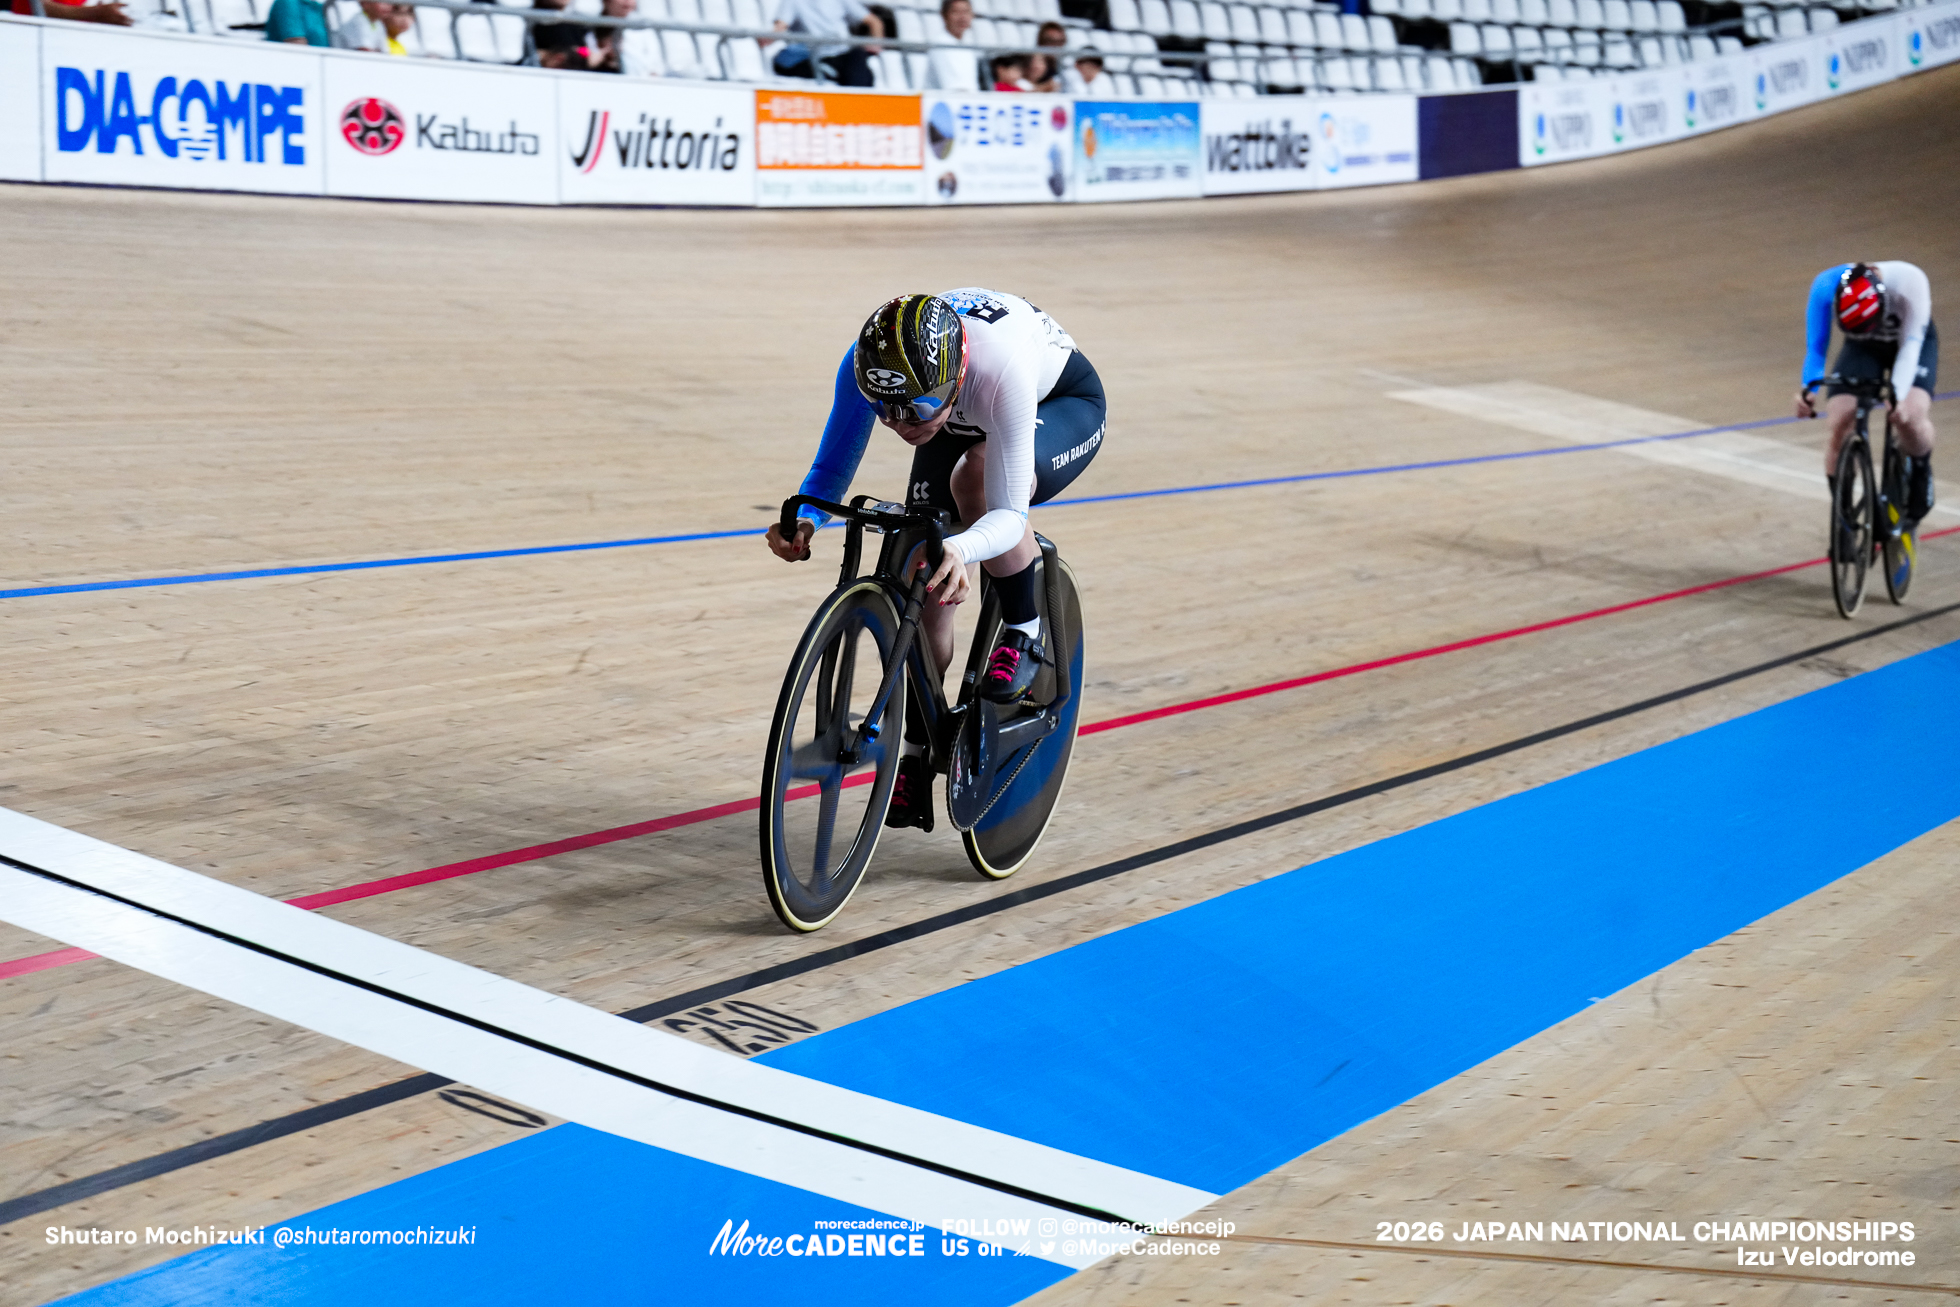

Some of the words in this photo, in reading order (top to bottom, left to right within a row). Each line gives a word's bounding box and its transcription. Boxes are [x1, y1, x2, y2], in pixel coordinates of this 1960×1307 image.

[56, 66, 306, 165] DIA-COMPE
[416, 114, 540, 156] Kabuto
[613, 112, 740, 171] vittoria
[1206, 118, 1310, 172] wattbike
[867, 383, 906, 395] Kabuto
[1051, 450, 1070, 471] TEAM
[1070, 428, 1101, 462] RAKUTEN
[662, 1001, 820, 1055] 250
